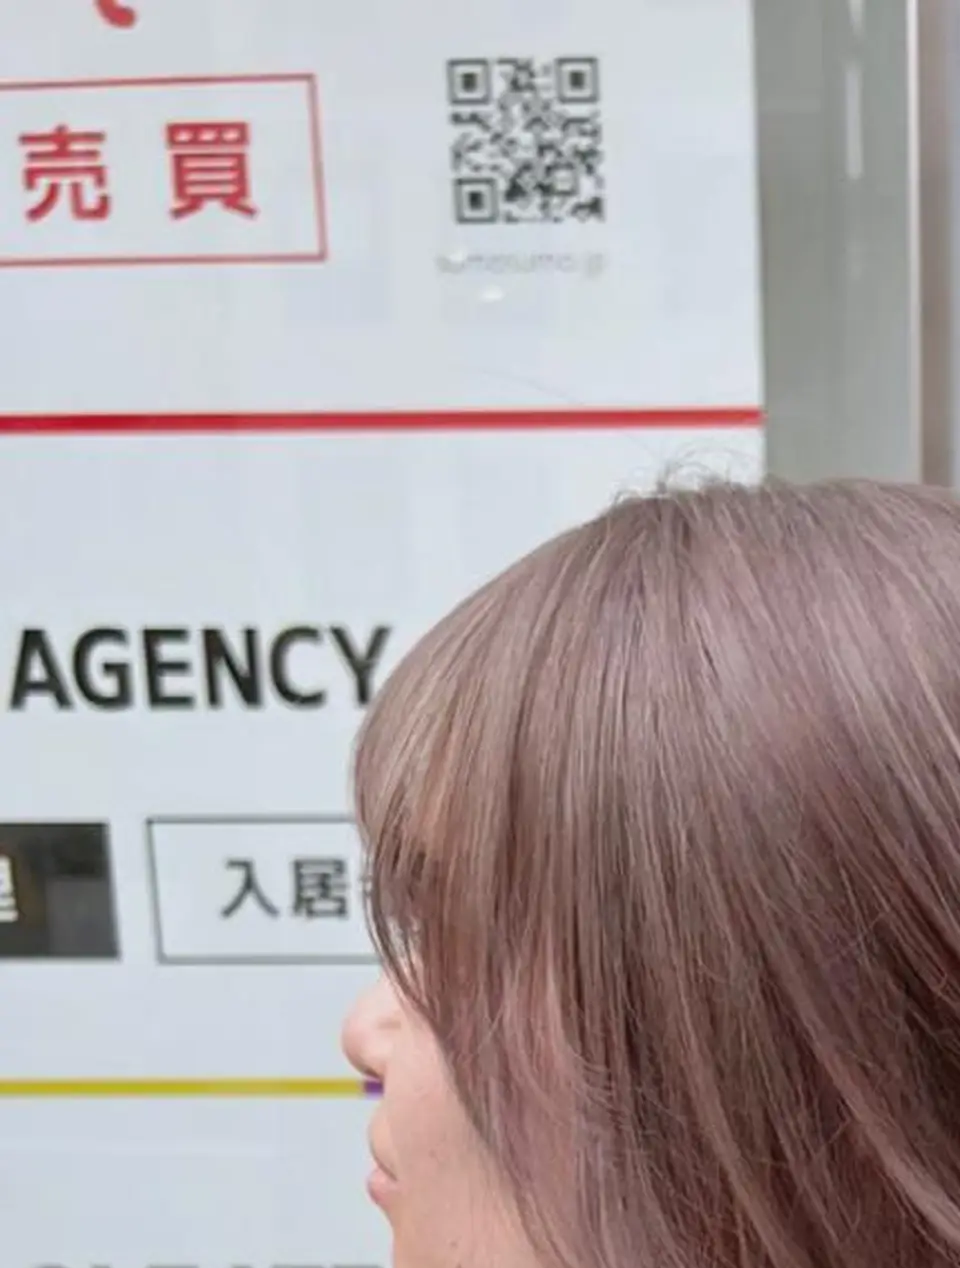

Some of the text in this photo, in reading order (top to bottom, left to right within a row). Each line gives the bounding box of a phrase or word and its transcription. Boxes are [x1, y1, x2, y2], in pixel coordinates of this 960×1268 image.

[18, 121, 257, 221] 売買
[8, 625, 391, 712] AGENCY
[220, 858, 372, 920] 入居
